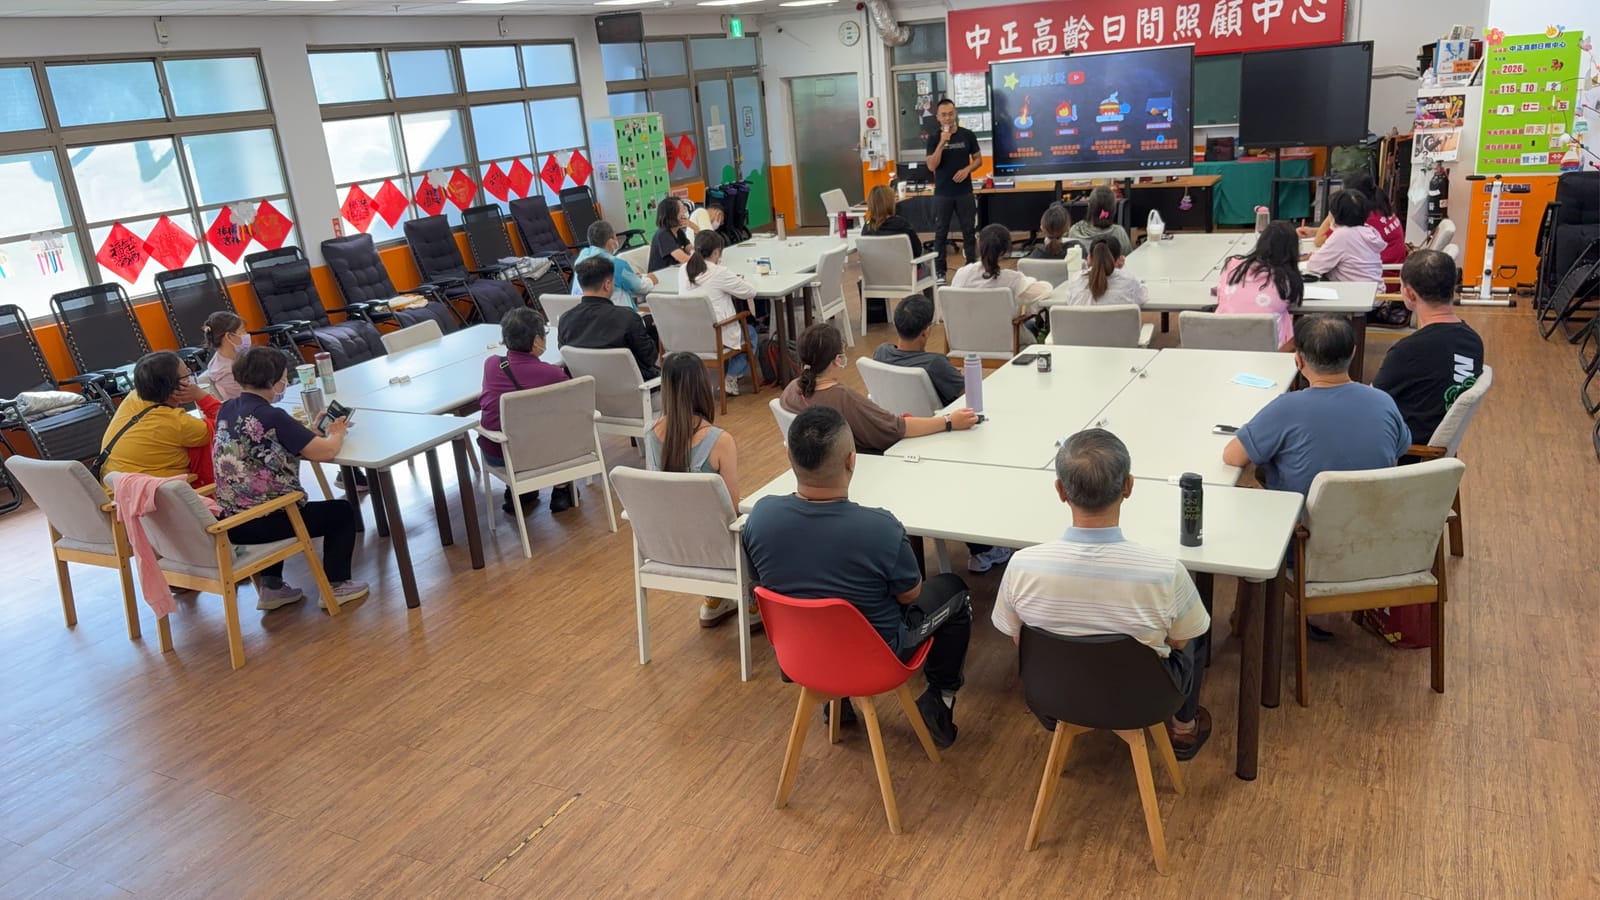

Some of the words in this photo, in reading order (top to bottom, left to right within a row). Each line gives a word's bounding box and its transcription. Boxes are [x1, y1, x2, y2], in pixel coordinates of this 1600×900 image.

[964, 0, 1328, 60] 中正高齡日間照顧中心
[1502, 64, 1522, 74] 2026
[1501, 84, 1515, 93] 115
[1525, 84, 1535, 92] 10
